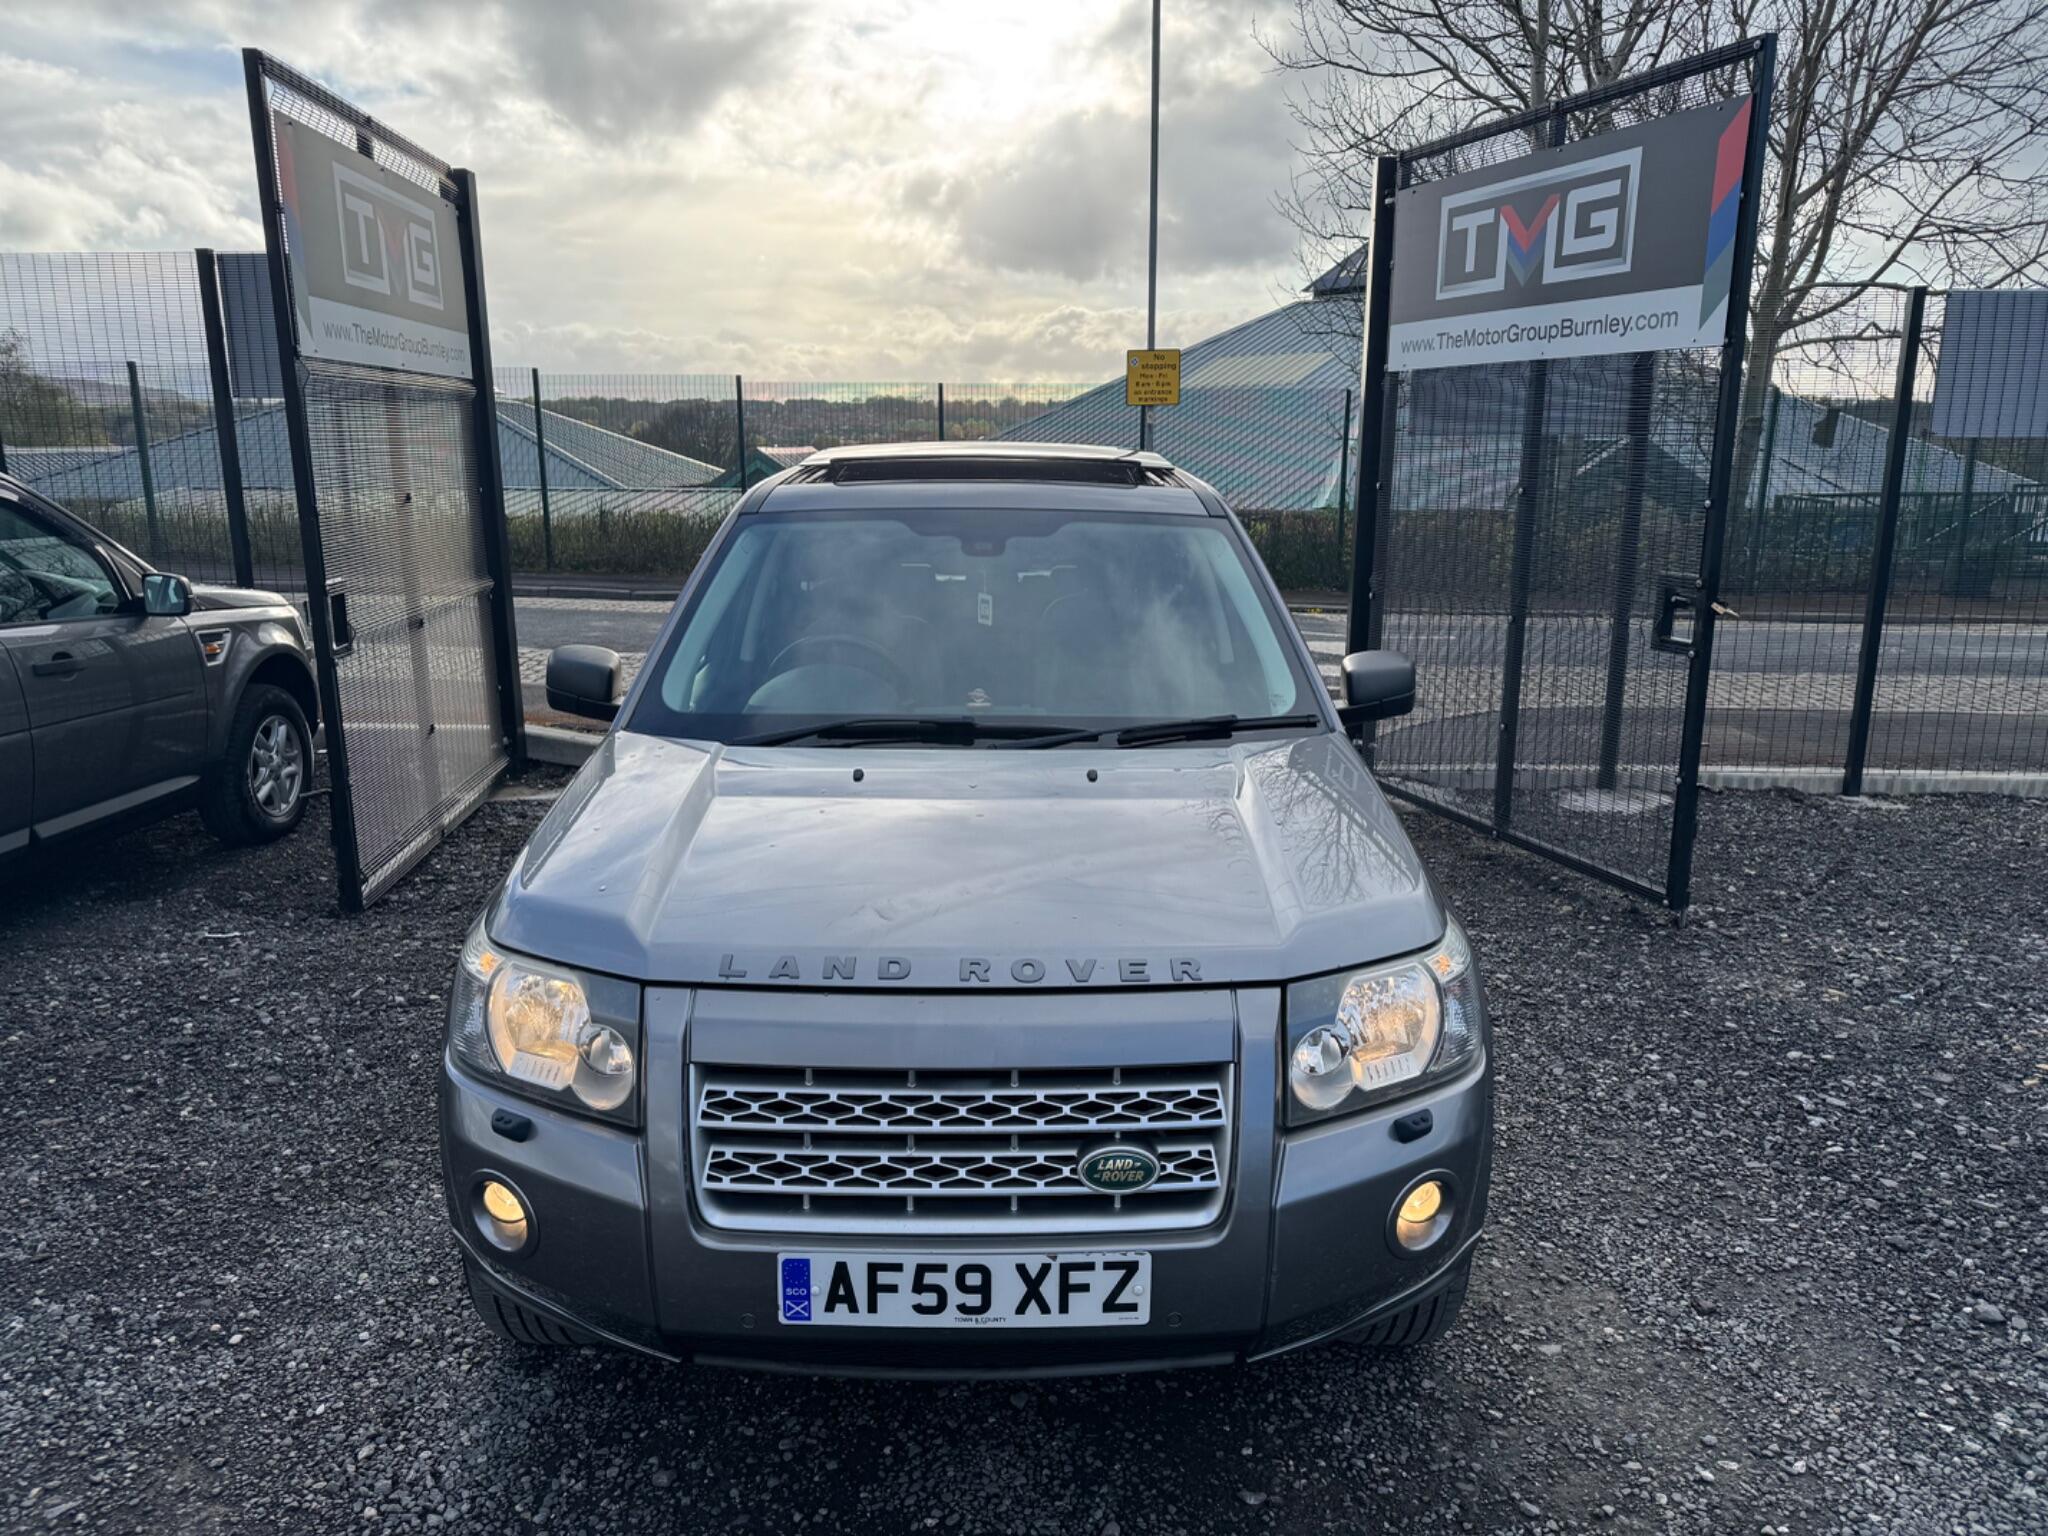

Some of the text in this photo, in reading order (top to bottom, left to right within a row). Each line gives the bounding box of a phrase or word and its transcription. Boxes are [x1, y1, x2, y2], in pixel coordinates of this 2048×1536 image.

[1448, 172, 1627, 290] TMG
[342, 186, 437, 298] TMG
[1400, 310, 1679, 353] www.TheMotorGroupBurnley.com
[1141, 362, 1177, 371] stopping
[1153, 353, 1165, 361] No
[718, 953, 1203, 983] LAND ROVER
[1097, 1159, 1134, 1170] LAND
[1101, 1170, 1144, 1182] ROVER
[785, 1287, 807, 1296] SCO
[824, 1260, 1140, 1316] AF59 XFZ
